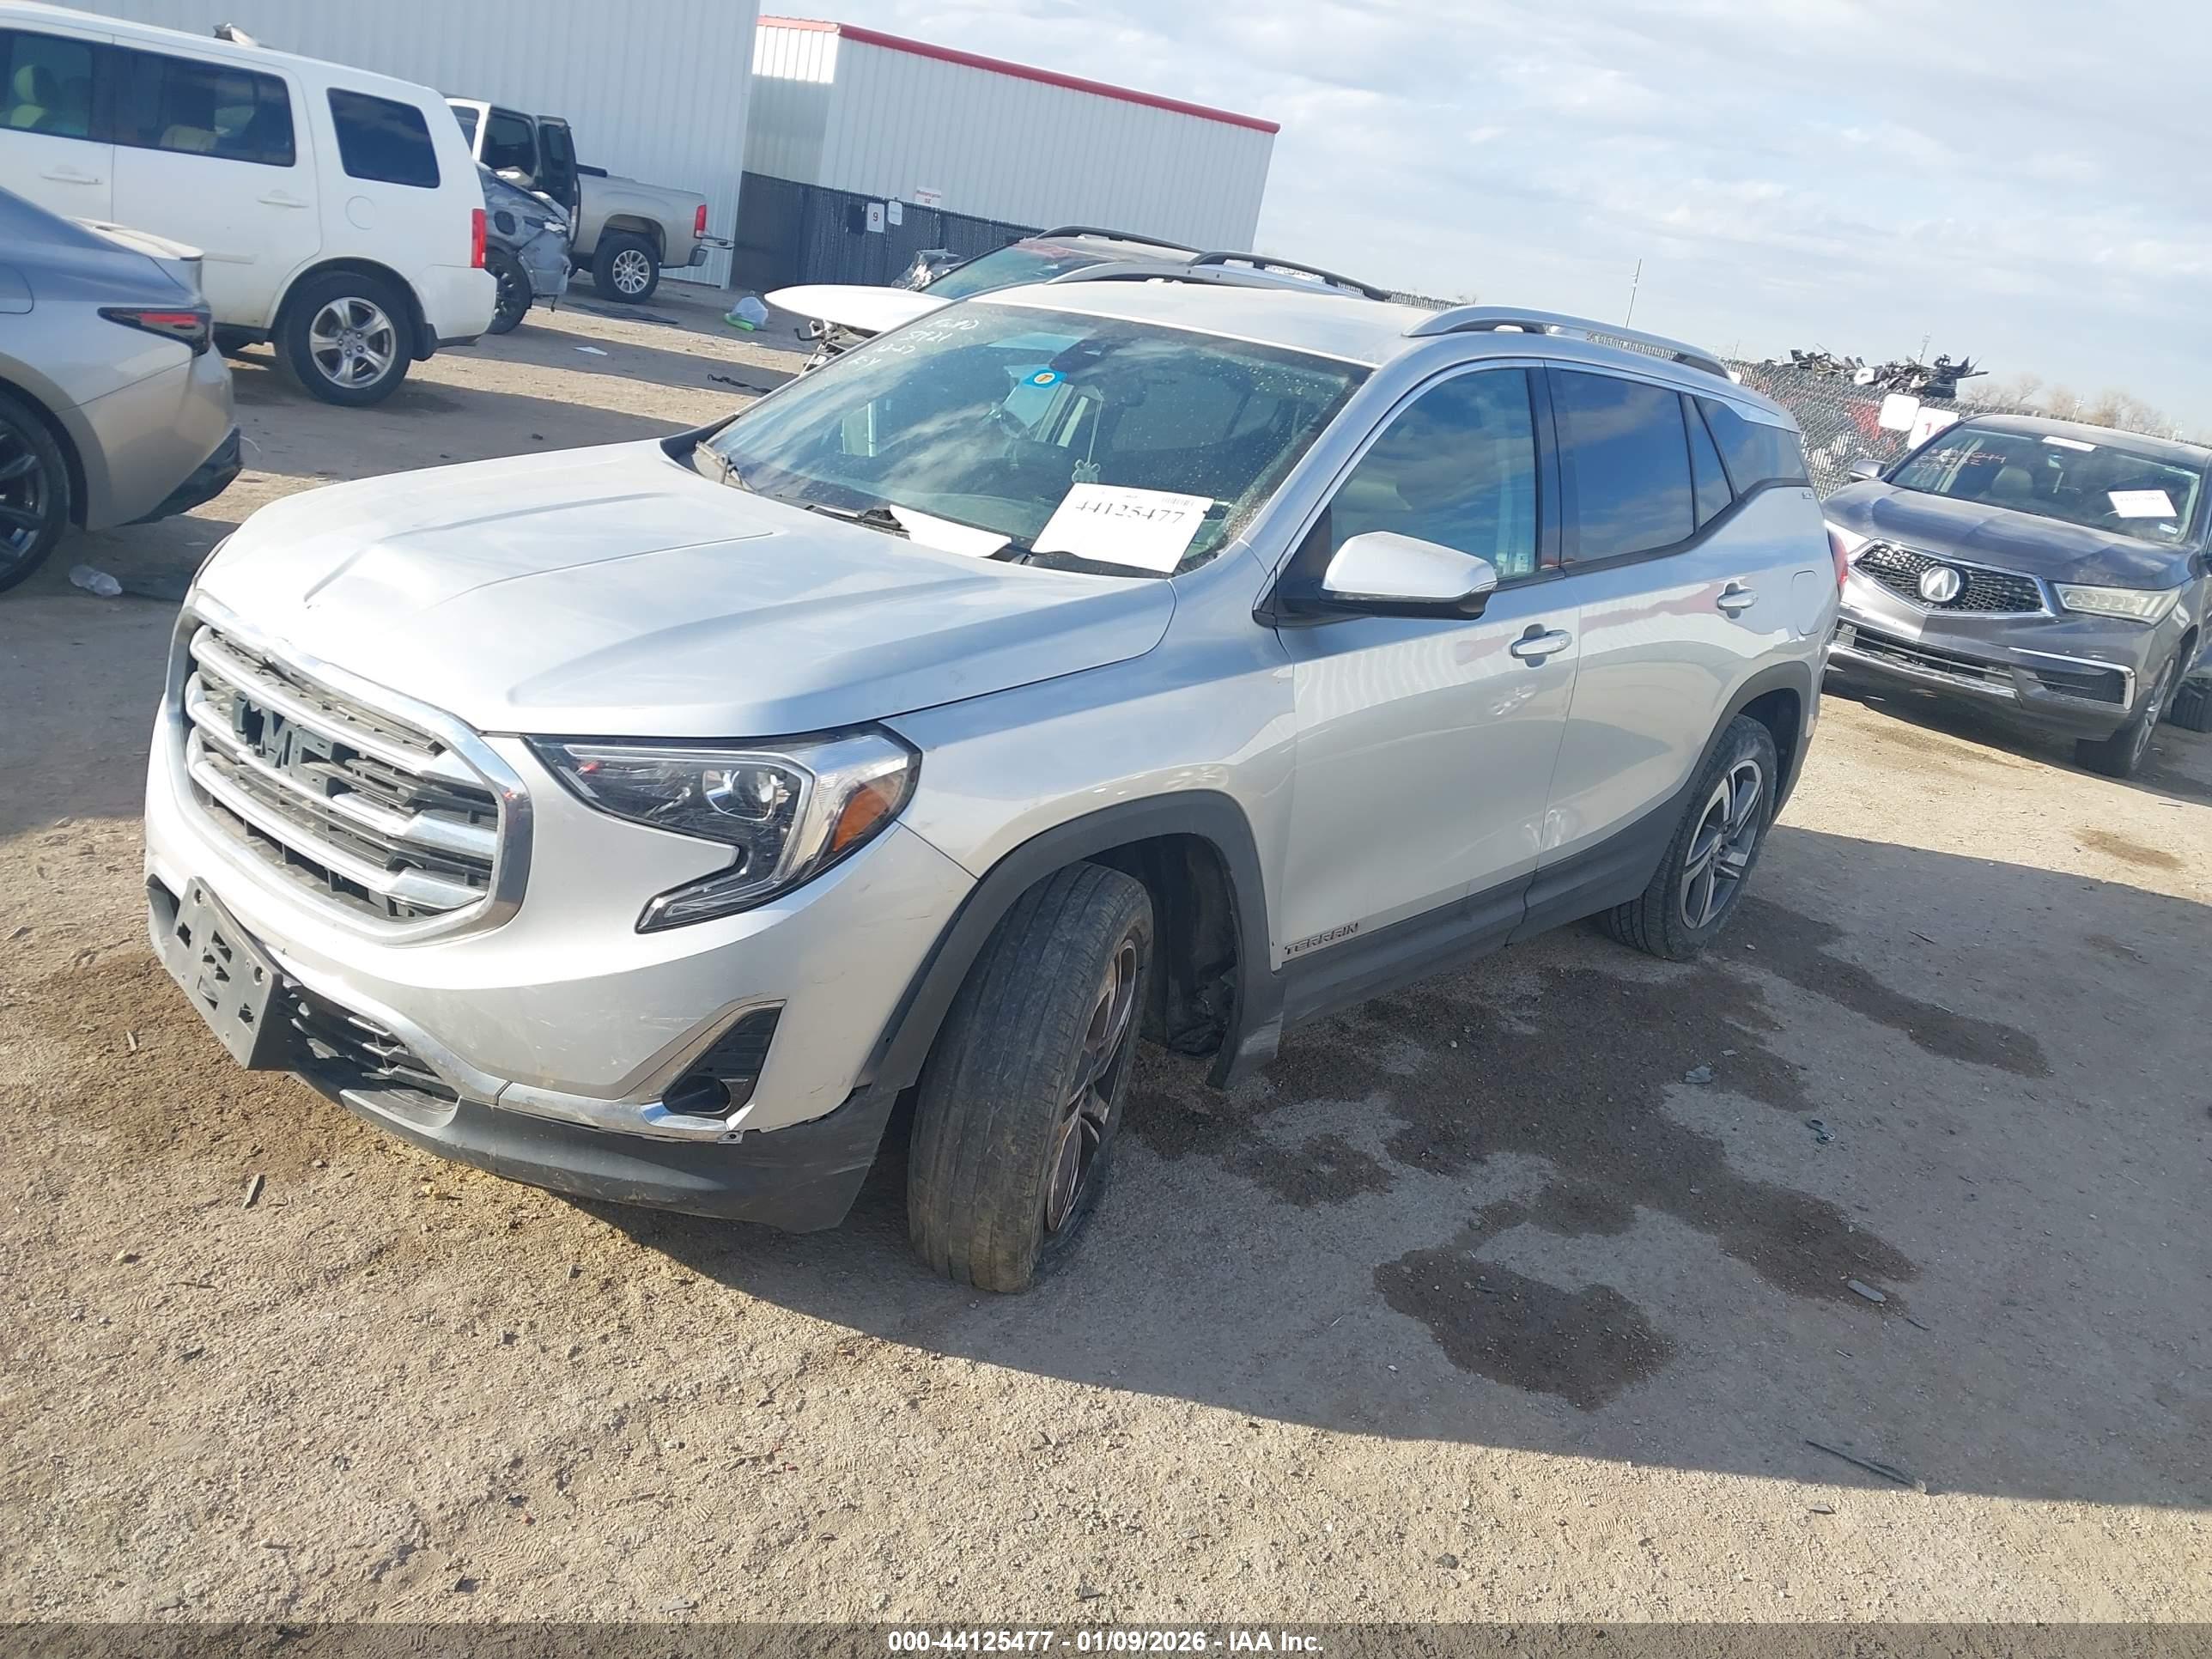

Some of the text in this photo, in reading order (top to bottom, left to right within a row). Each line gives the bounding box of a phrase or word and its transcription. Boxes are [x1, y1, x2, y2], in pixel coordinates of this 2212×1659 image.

[872, 211, 879, 222] 9
[1076, 501, 1185, 524] 44125477
[1285, 921, 1359, 956] TERRAIN
